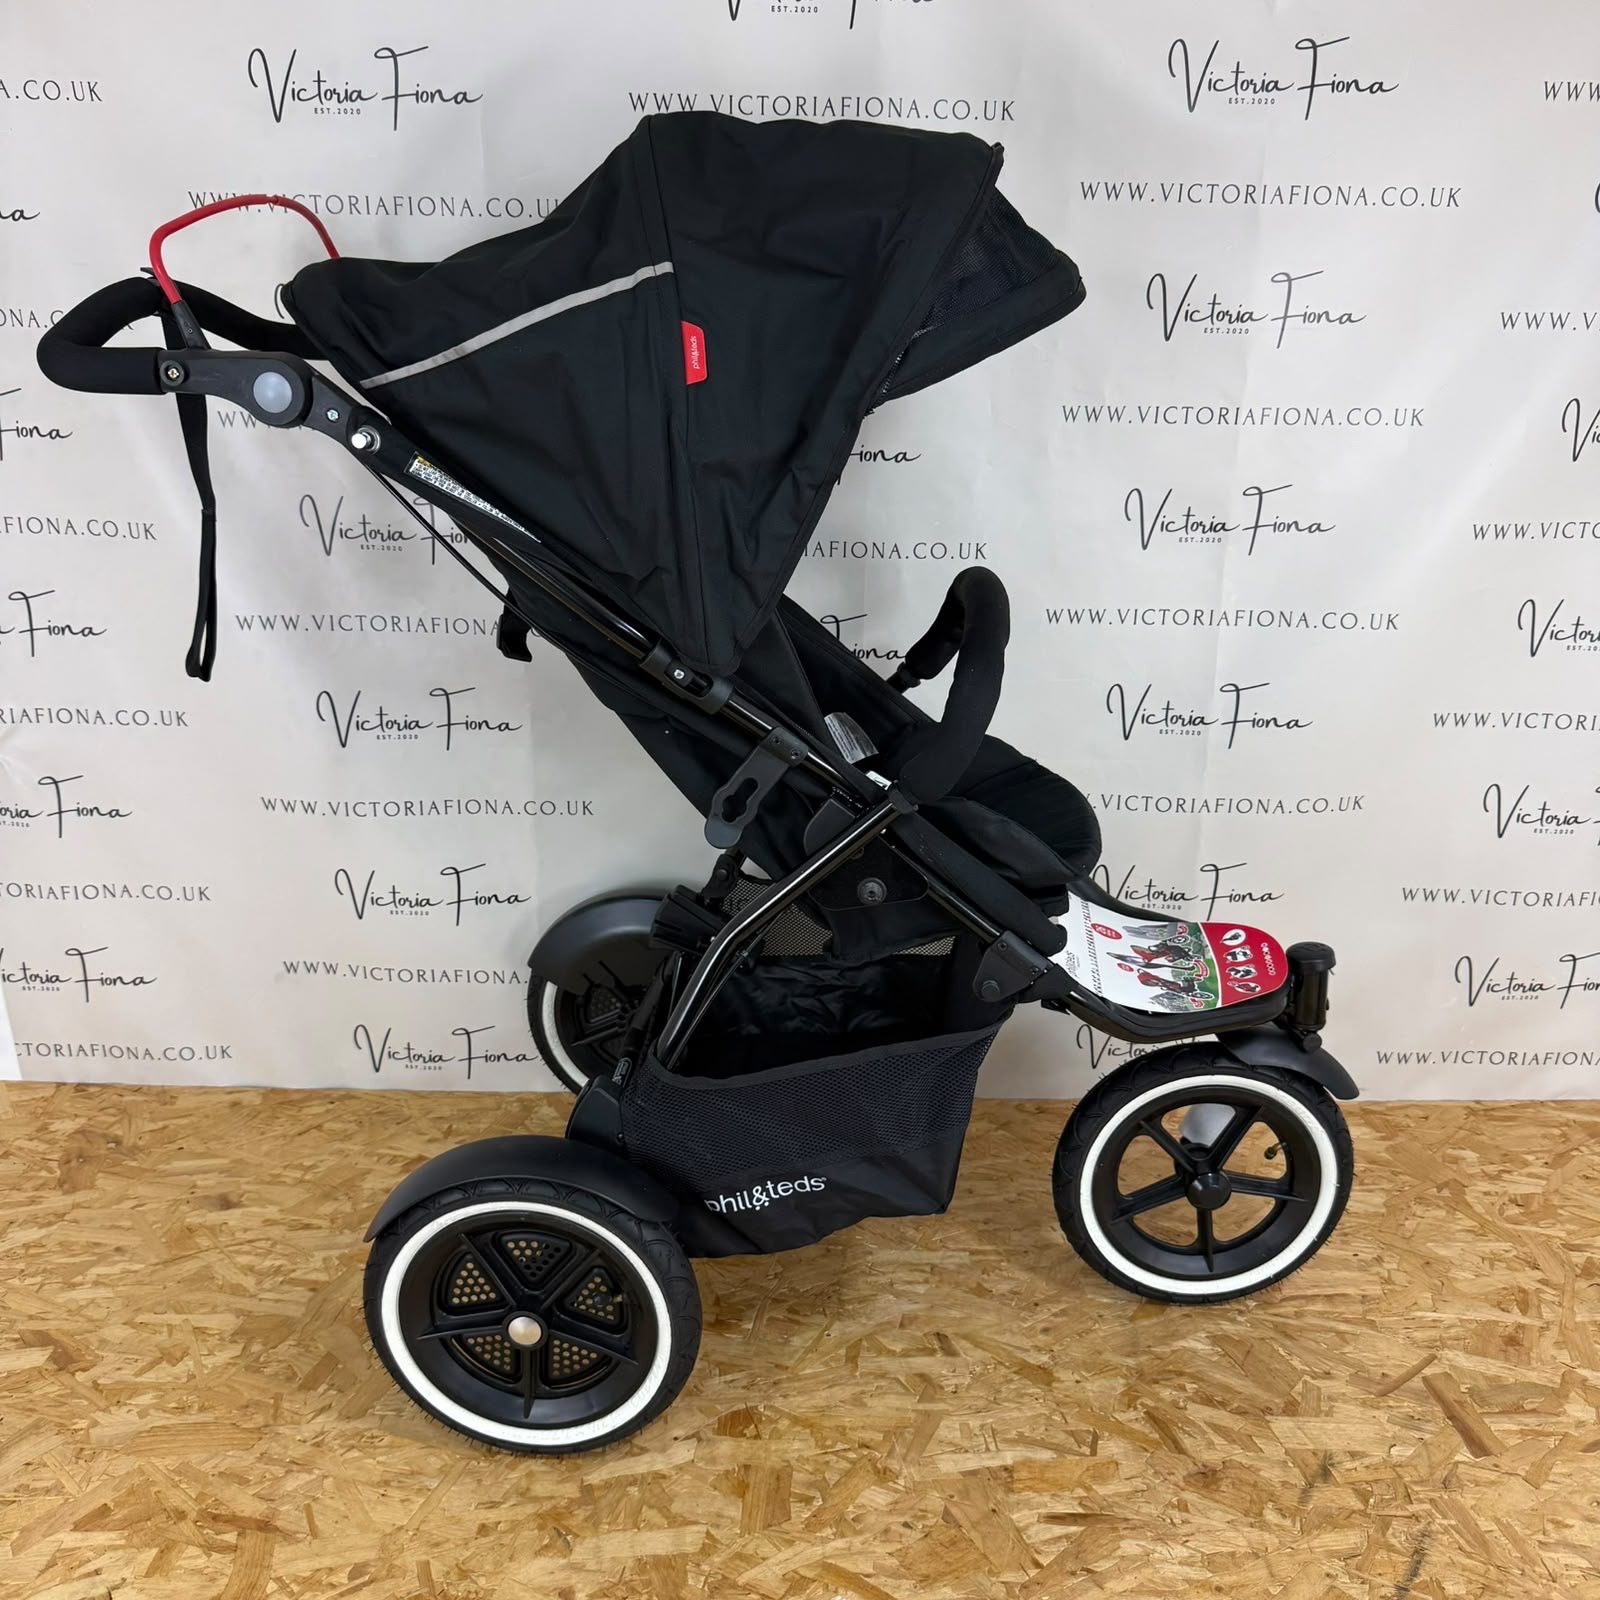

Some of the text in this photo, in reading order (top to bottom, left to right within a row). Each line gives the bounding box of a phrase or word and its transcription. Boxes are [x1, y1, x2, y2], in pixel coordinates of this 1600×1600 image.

[771, 5, 819, 13] EST.2020
[247, 45, 484, 132] Victoria Fiona
[1168, 36, 1400, 121] Victoria Fiona
[1228, 97, 1276, 106] EST.2020
[313, 107, 362, 116] EST.2020
[1080, 181, 1462, 208] WWW.VICTORIAFIONA.CO.UK
[1146, 270, 1367, 349] Victoria Fiona
[1203, 328, 1250, 336] EST.2020
[1062, 405, 1424, 427] WWW.VICTORIAFIONA.CO.UK
[850, 445, 921, 463] iona
[0, 516, 157, 540] FIONA.CO.UK
[300, 494, 416, 556] Victoria
[1124, 484, 1336, 555] Victoria Fiona
[8, 589, 107, 658] Fiona
[1046, 608, 1399, 631] WWW.VICTORIAFIONA.CO.UK
[316, 687, 523, 751] Victoria Fiona
[1106, 683, 1313, 749] Victoria Fiona
[1159, 728, 1201, 736] EST.2020
[1433, 712, 1600, 732] WWW.VICTORI
[38, 775, 132, 838] Fiona
[261, 797, 594, 818] WWW.VICTORIAFIONA.CO.UK
[1483, 783, 1591, 838] Victoria
[0, 883, 211, 902] ORIAFIONA.CO.UK
[335, 864, 531, 926] Victoria Fiona
[1200, 863, 1284, 921] Fiona
[65, 947, 157, 1002] Fiona
[1455, 956, 1555, 1007] Victoria
[353, 1025, 539, 1079] Victoria Fiona
